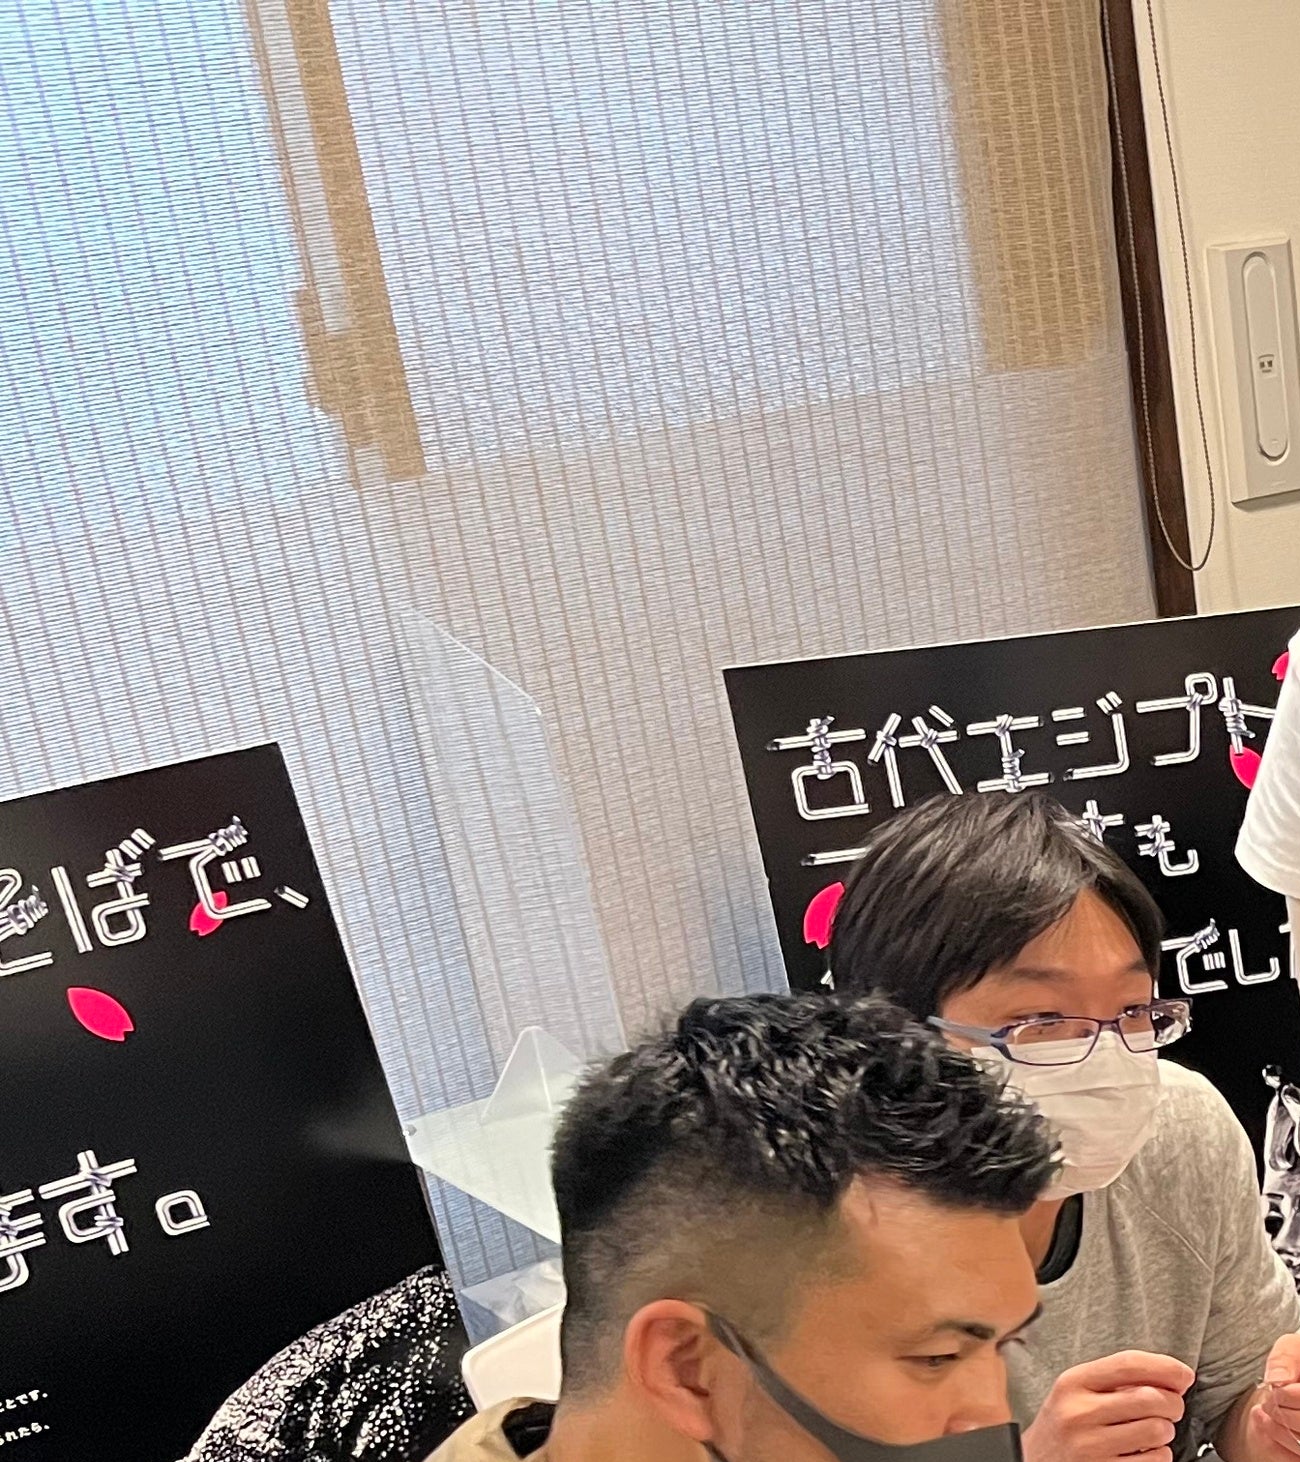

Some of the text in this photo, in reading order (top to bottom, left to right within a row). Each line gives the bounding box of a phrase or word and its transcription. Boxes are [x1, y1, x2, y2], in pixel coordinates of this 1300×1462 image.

[766, 672, 1276, 821] 古代エジプト
